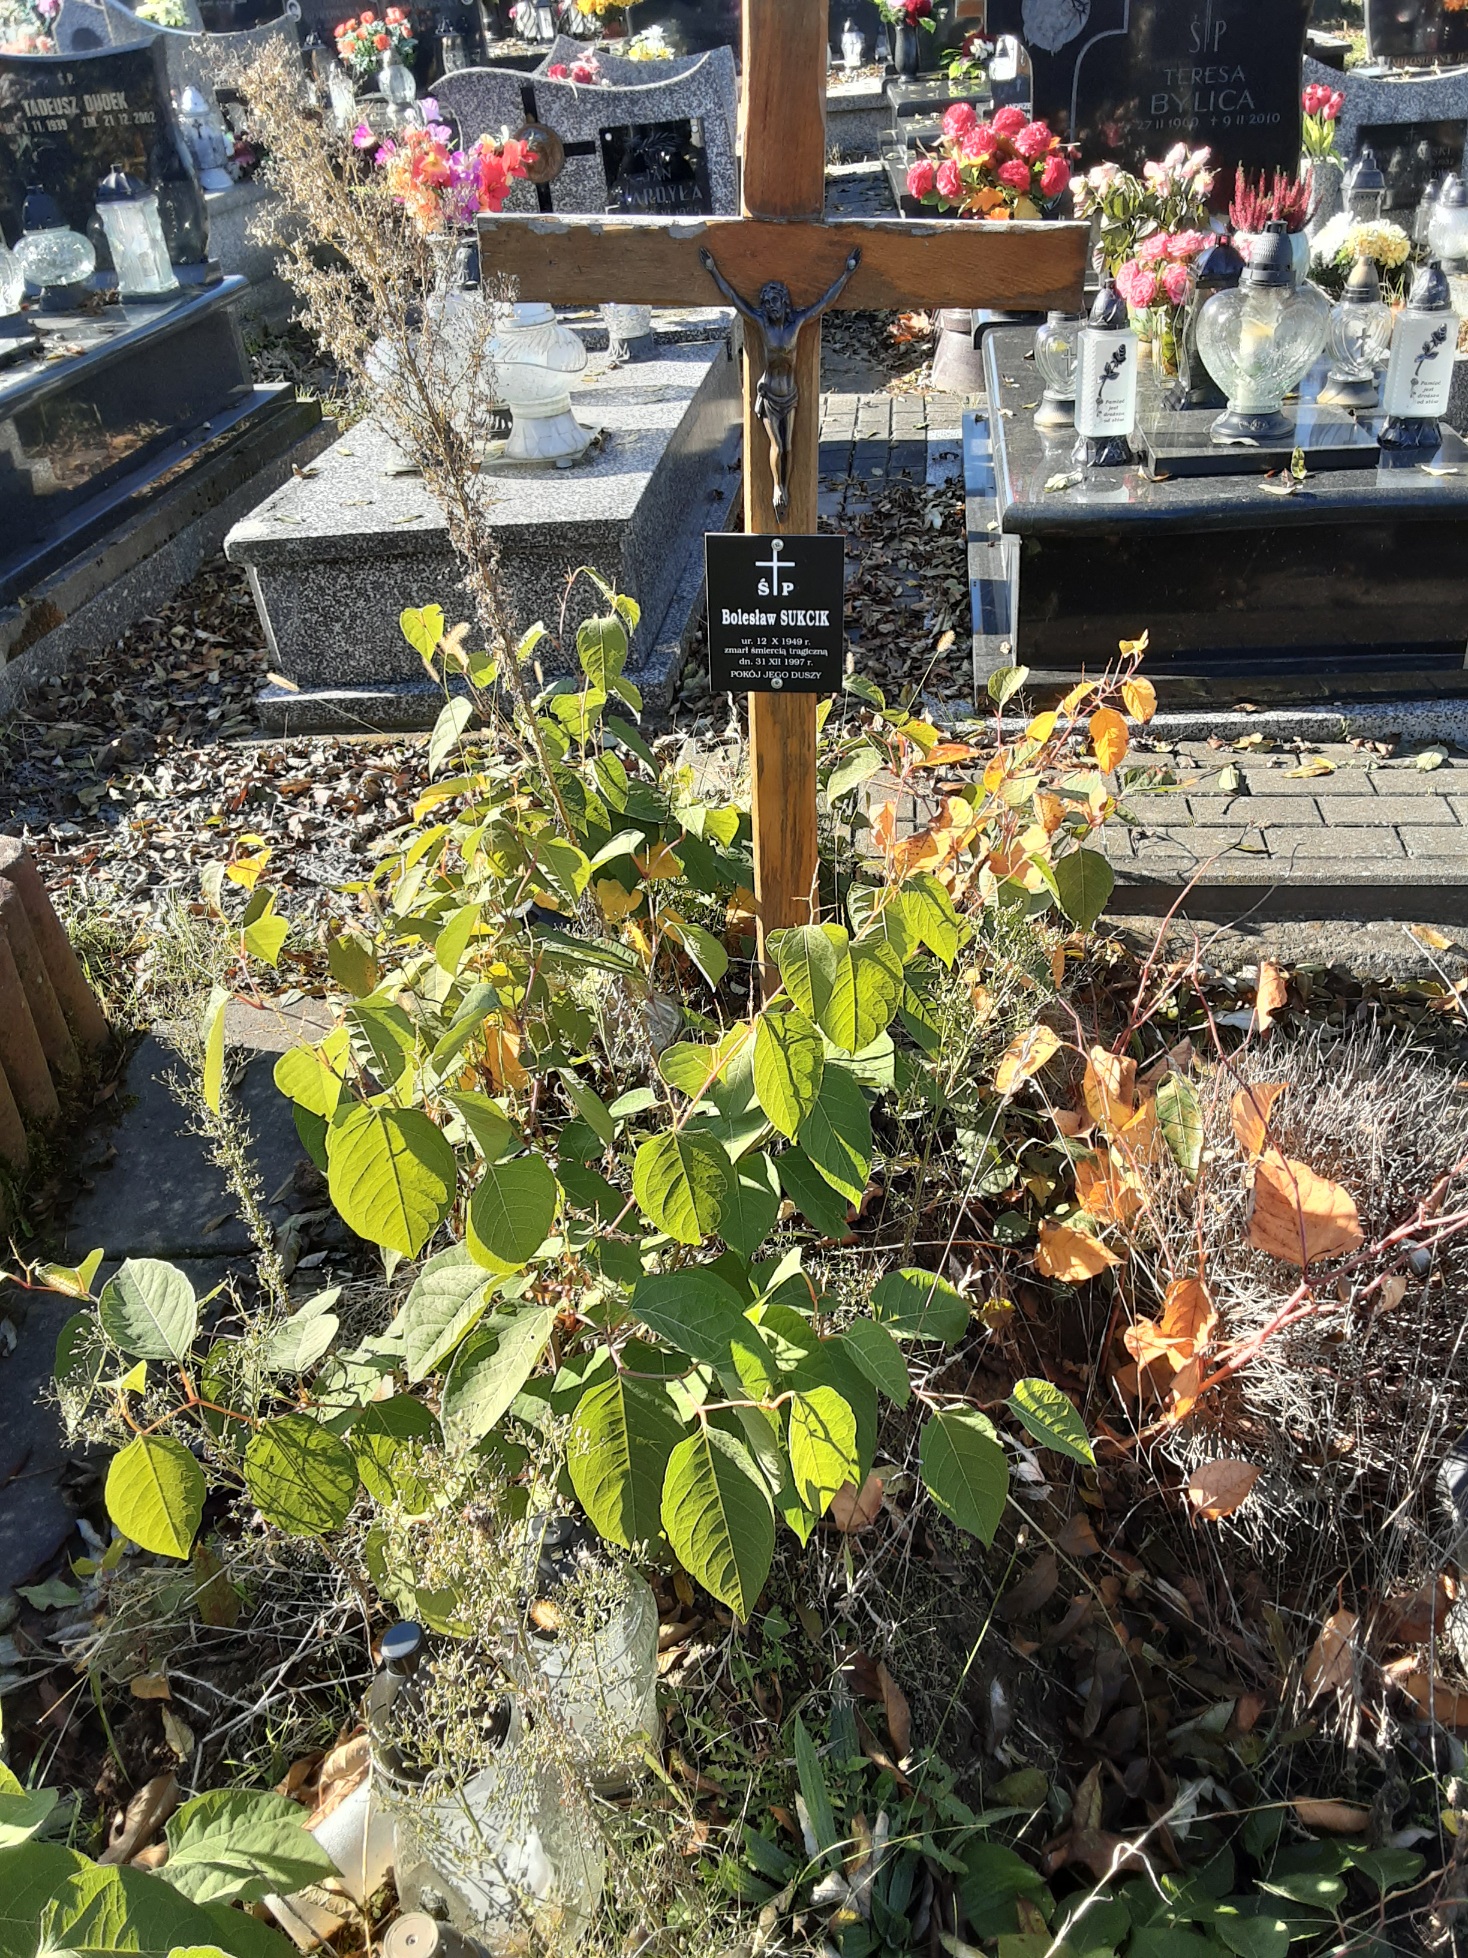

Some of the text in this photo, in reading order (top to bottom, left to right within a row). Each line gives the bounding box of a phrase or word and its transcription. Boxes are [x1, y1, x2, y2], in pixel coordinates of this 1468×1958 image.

[1214, 20, 1227, 52] P
[1164, 65, 1246, 86] TERESA
[21, 91, 129, 118] TADEUSZ DUDEK
[1150, 89, 1256, 115] BYLICA
[46, 117, 69, 132] 1939
[81, 115, 100, 129] ZM.
[133, 110, 157, 124] 2002
[1249, 112, 1281, 124] 2010
[757, 578, 795, 596] Ś P
[721, 608, 830, 626] Bolesław SUKCIK
[724, 646, 828, 656] zmarł śmiercią tragiczną
[782, 638, 803, 646] 1949
[739, 658, 753, 666] dn.
[755, 658, 766, 666] 31
[768, 658, 781, 666] XII
[784, 658, 805, 666] 1997
[730, 669, 822, 680] POKÓJ JEGO DUSZY
